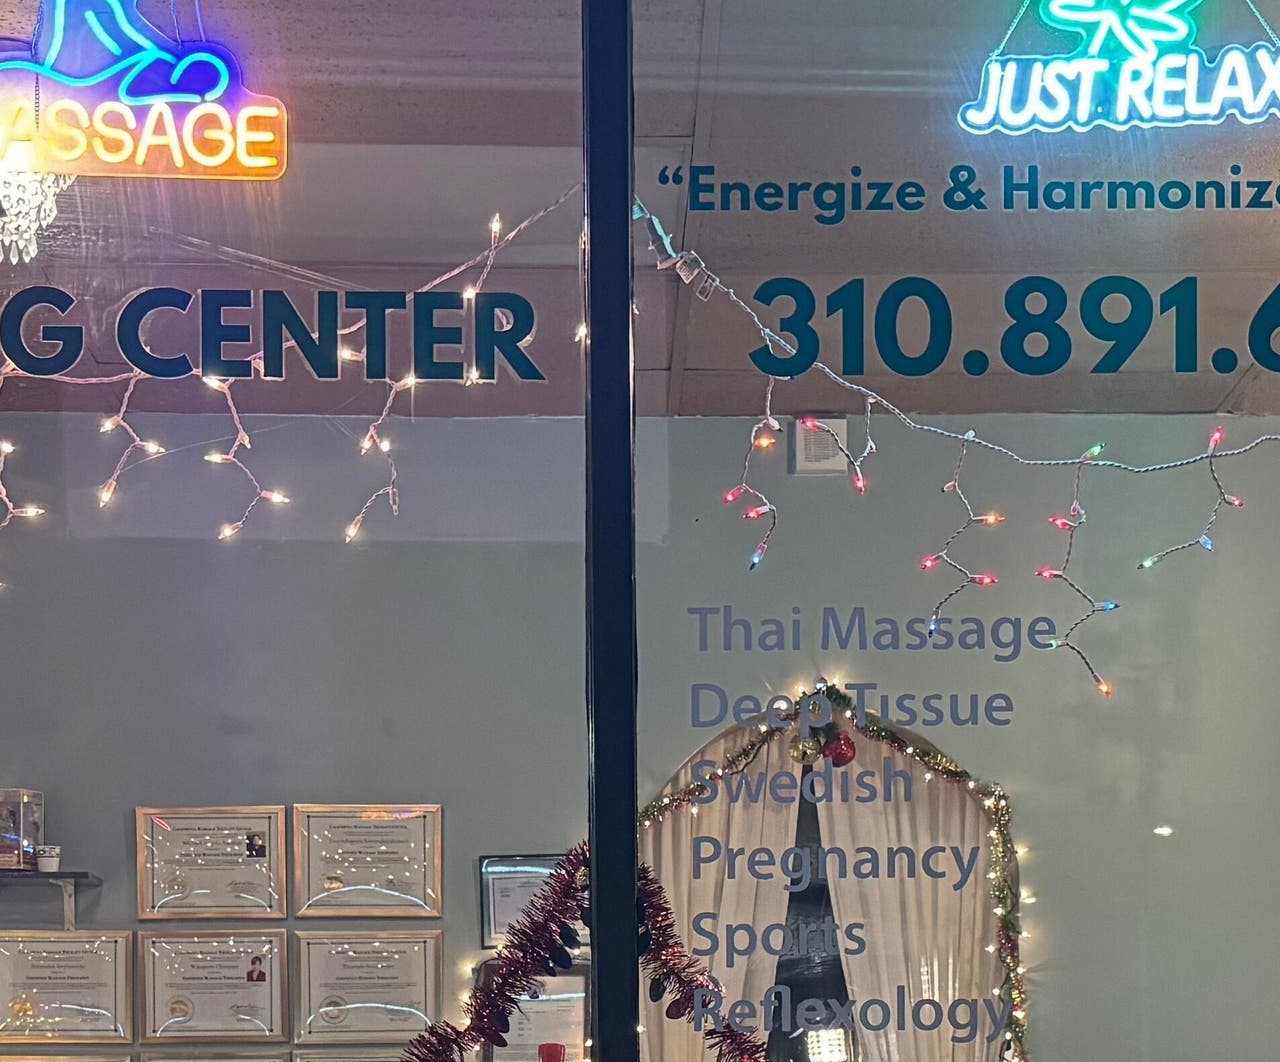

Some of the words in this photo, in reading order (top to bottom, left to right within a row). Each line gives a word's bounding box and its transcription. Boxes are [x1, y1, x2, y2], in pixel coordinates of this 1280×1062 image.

[966, 60, 1109, 126] JUST
[943, 166, 986, 211] &
[116, 287, 546, 381] CENTER
[688, 607, 801, 651] Thai
[822, 607, 1057, 662] Massage
[690, 684, 830, 738] Deep
[846, 682, 1014, 726] Tissue
[690, 757, 912, 804] Swedish
[692, 837, 980, 892] Pregnancy
[692, 912, 866, 967] Sports
[694, 985, 1013, 1044] Reflexology
